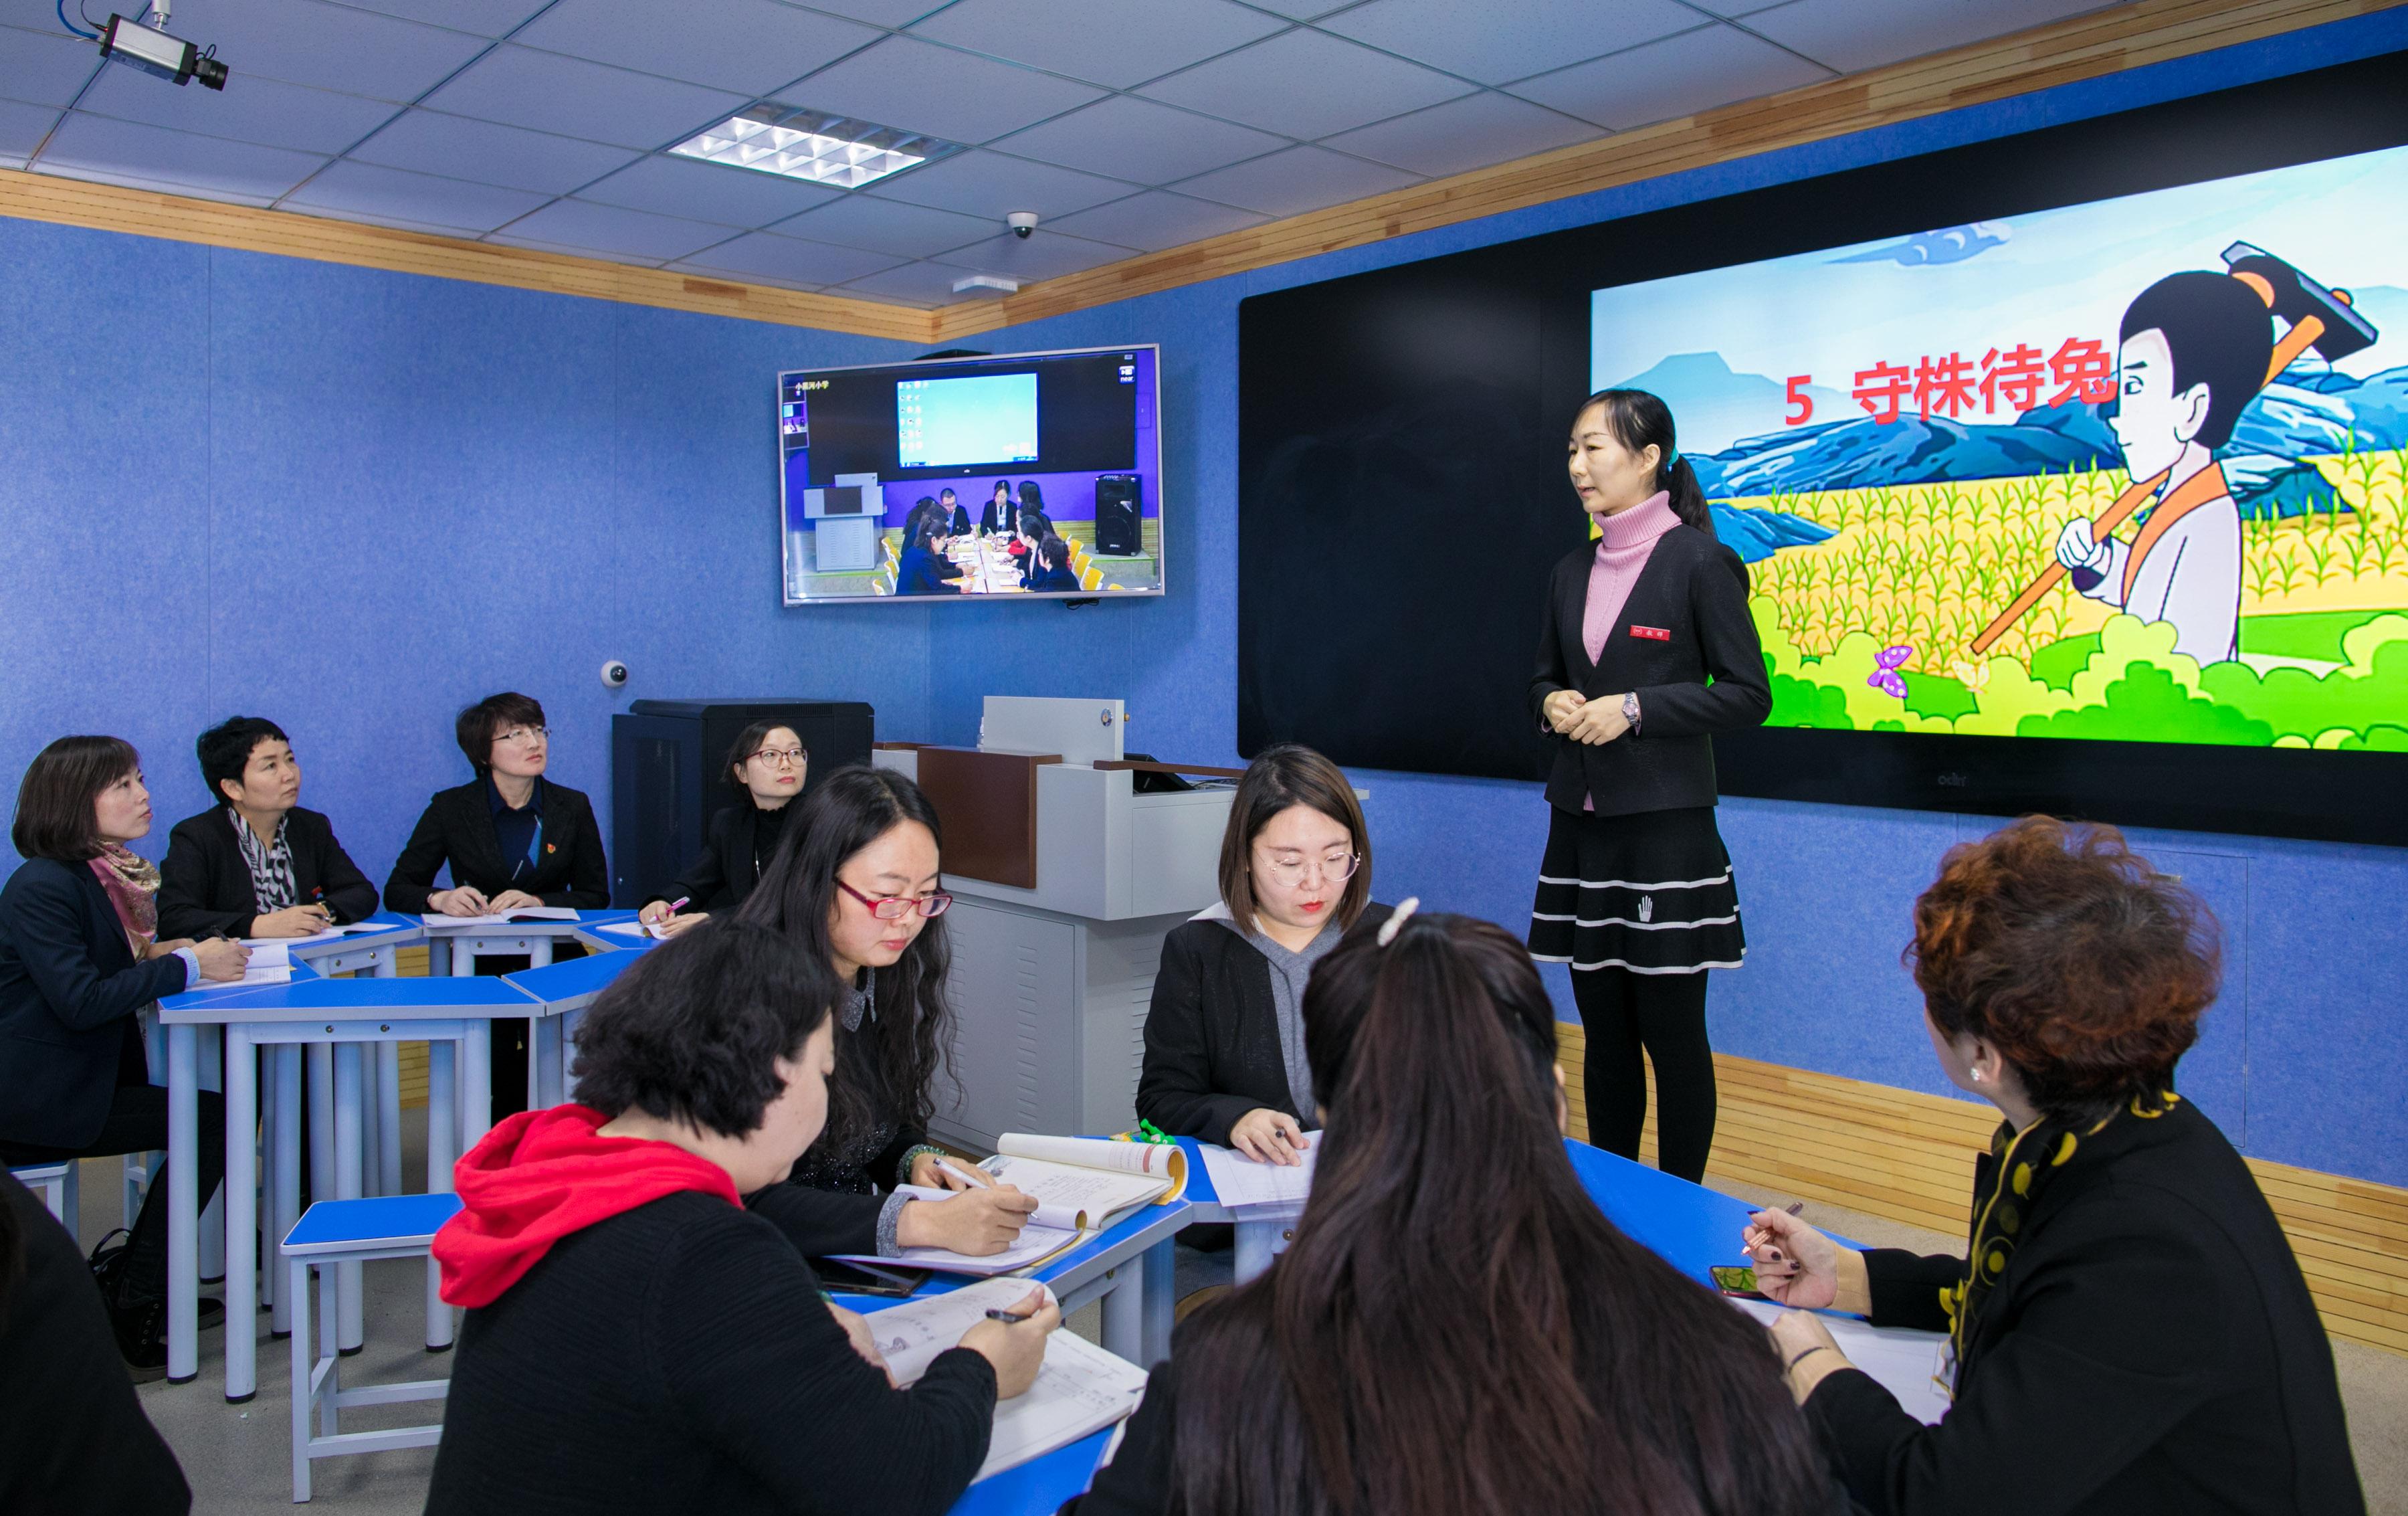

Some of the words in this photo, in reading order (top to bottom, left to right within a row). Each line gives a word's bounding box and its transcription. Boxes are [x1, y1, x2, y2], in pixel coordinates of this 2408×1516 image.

[1785, 375, 1813, 425] 5
[1851, 337, 2118, 426] 守株待兔
